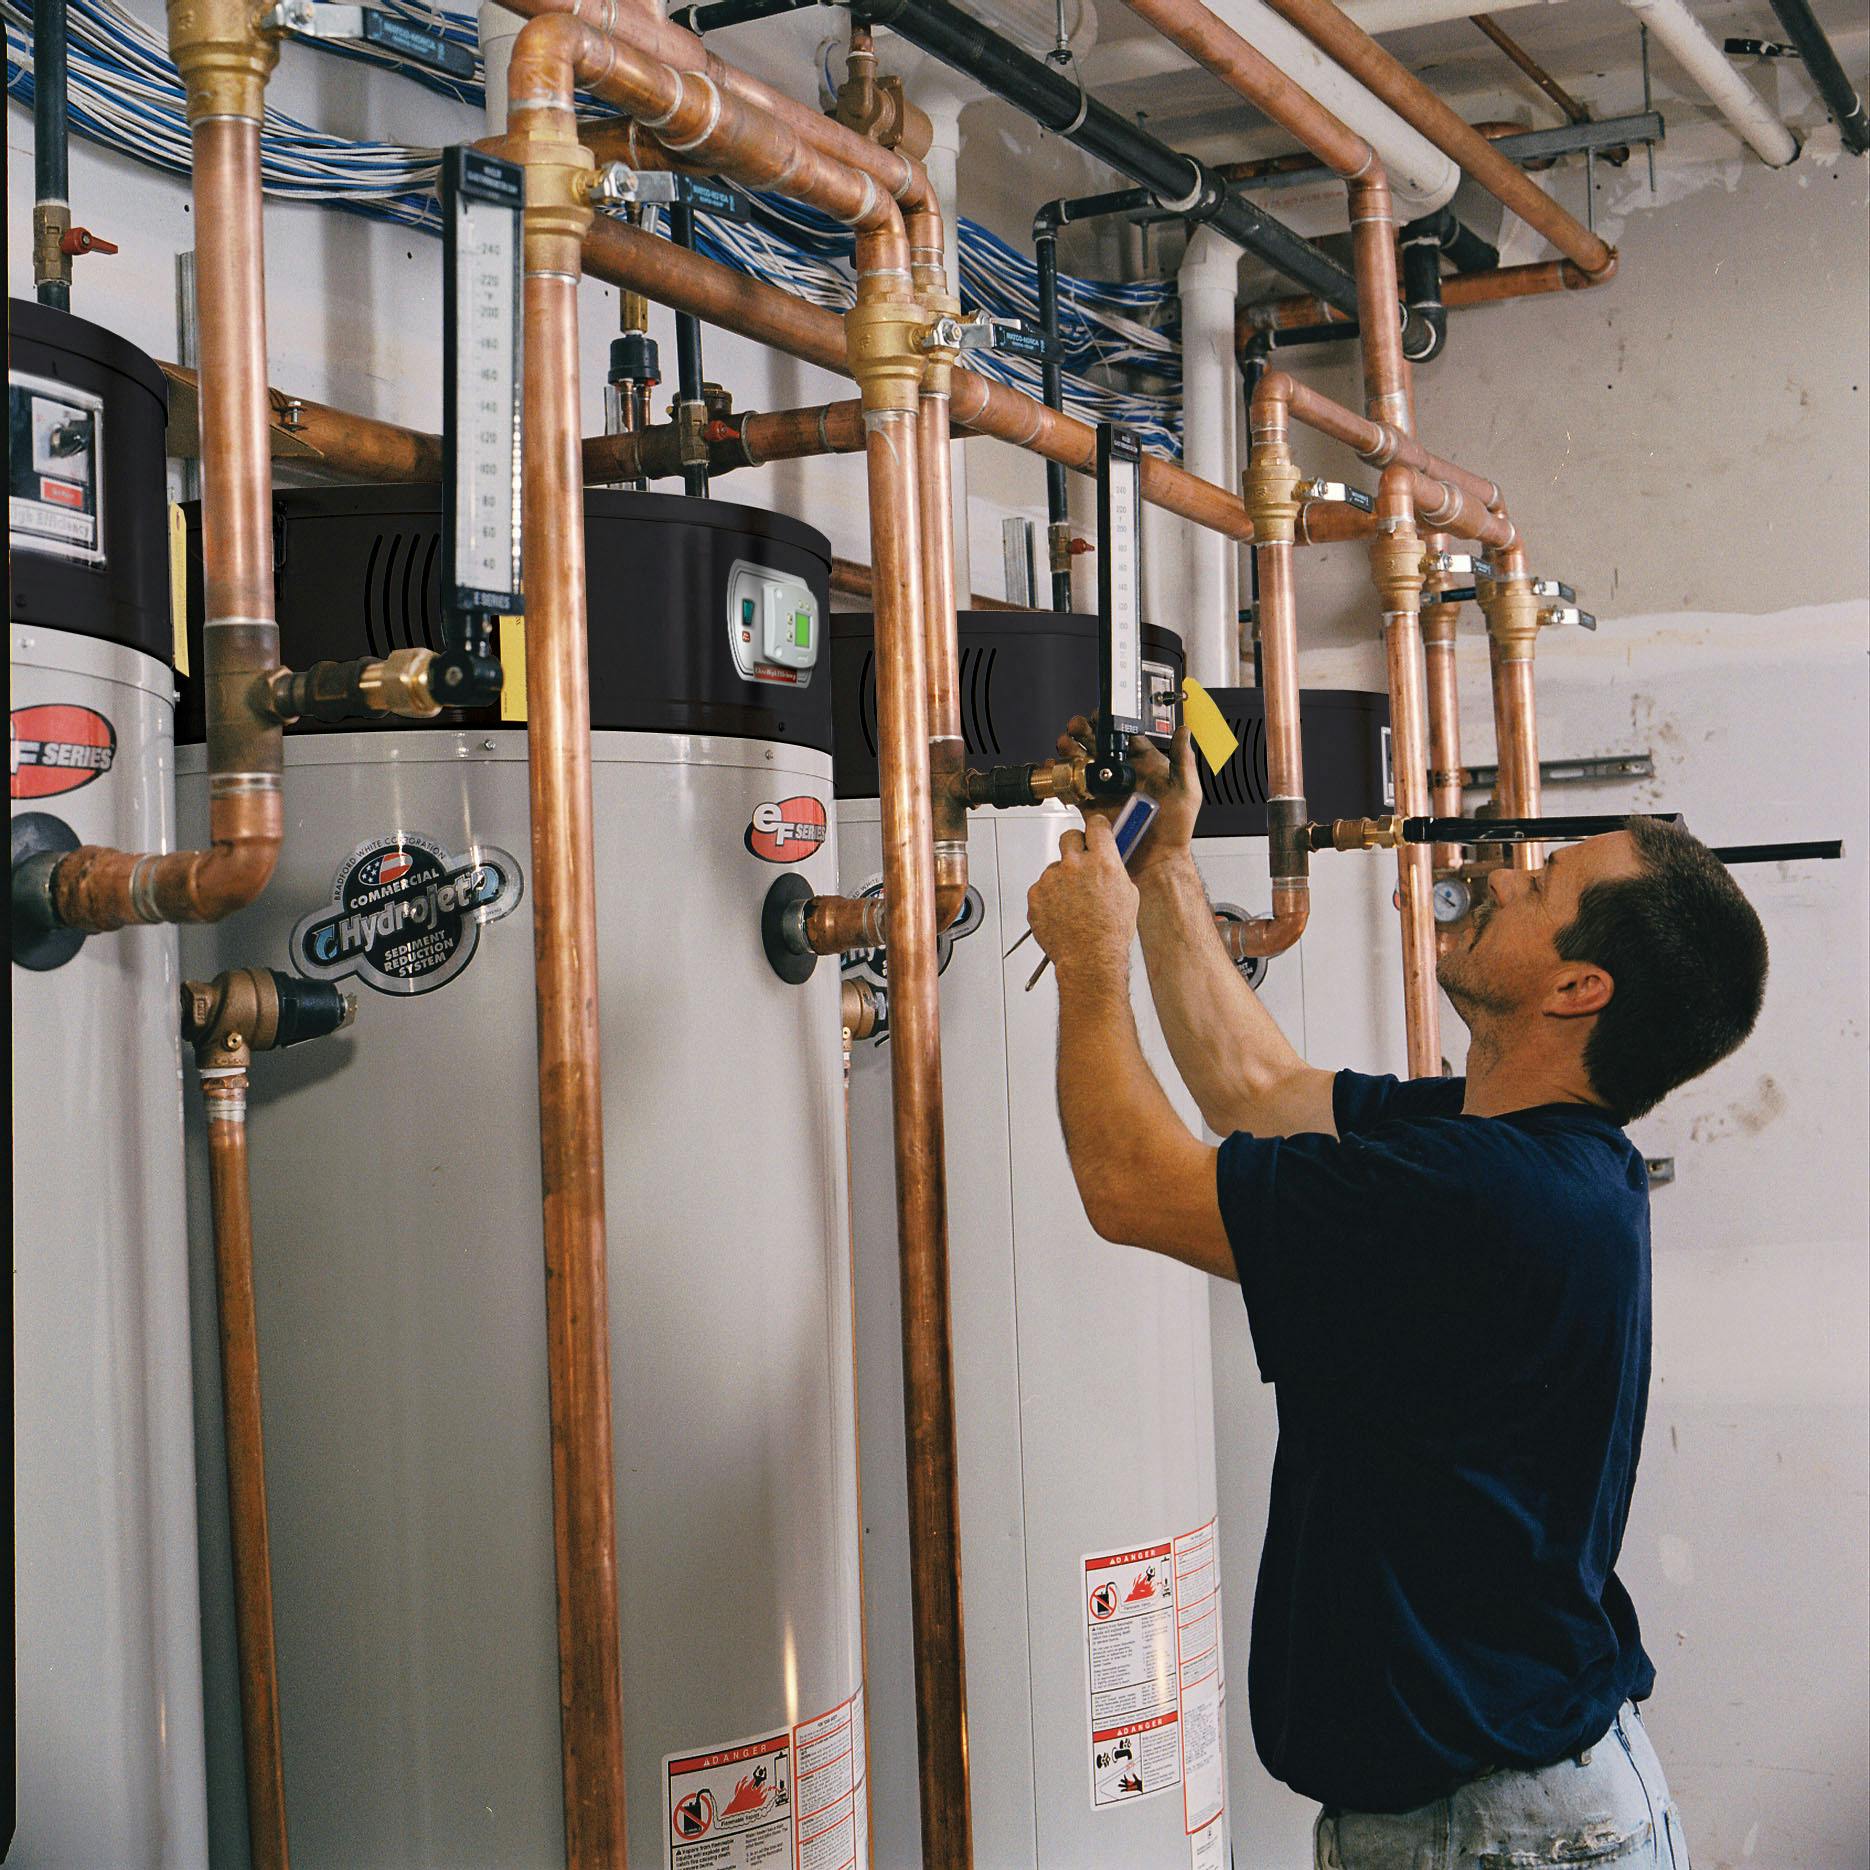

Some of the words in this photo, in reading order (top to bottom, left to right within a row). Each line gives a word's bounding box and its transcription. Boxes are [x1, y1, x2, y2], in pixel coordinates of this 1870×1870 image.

[483, 558, 495, 570] 40
[41, 742, 112, 769] SERIES
[795, 823, 826, 842] SERIES
[334, 856, 357, 901] BRADFORD
[357, 839, 382, 858] WHITE
[350, 868, 440, 910] COMMERCIAL
[339, 873, 472, 952] Hydrojet
[384, 929, 447, 961] SEDIMENT
[384, 938, 454, 972] REDUCTION
[398, 952, 447, 978] SYSTEM
[1116, 1549, 1156, 1564] DANGER
[1123, 1718, 1163, 1735] DANGER
[712, 1744, 767, 1765] DANGER
